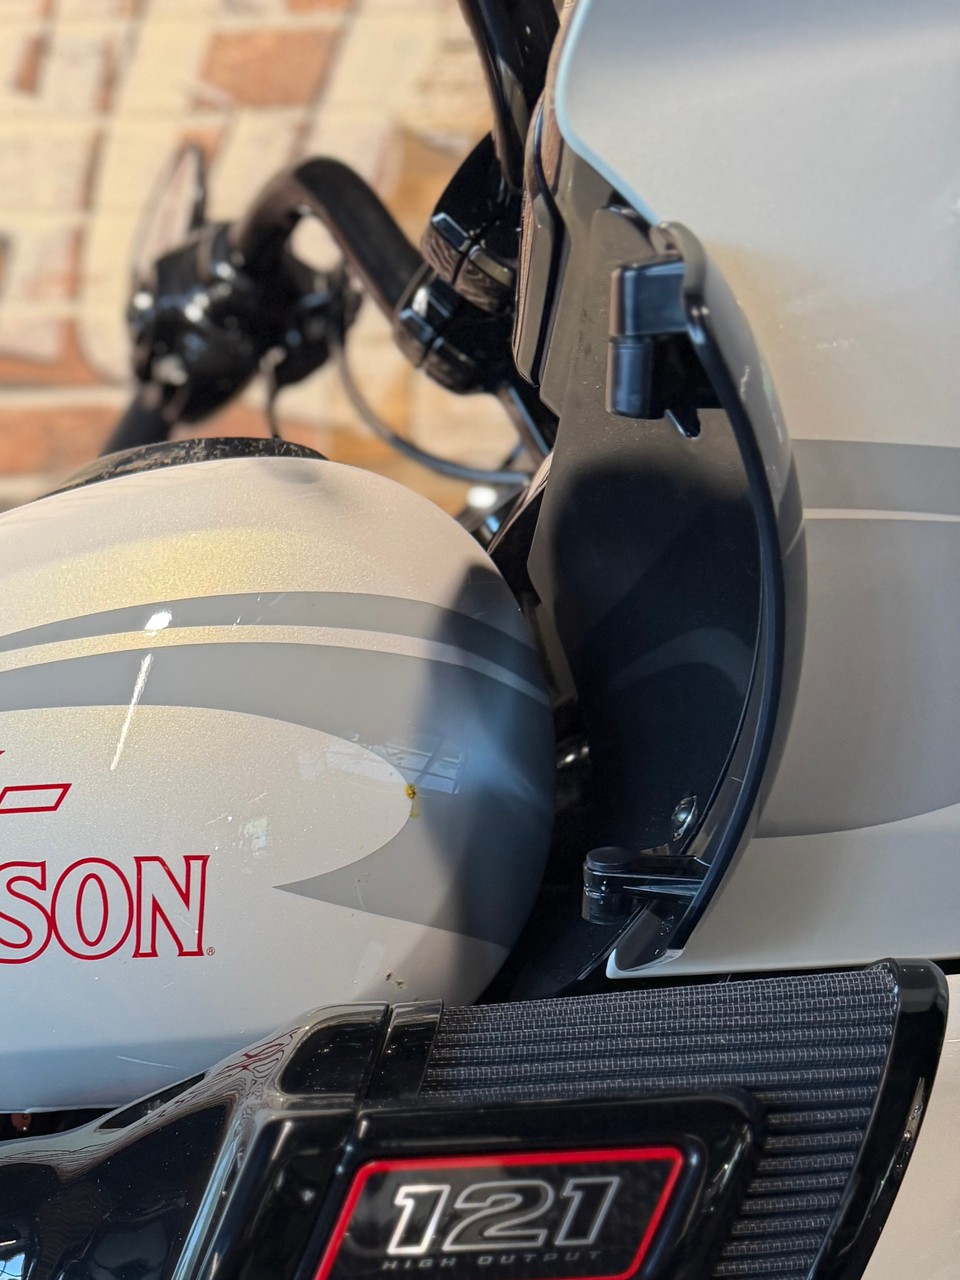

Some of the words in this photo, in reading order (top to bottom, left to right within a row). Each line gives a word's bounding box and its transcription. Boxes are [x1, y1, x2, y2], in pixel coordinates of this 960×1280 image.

[386, 1175, 621, 1255] 121
[382, 1257, 457, 1271] HIGH
[477, 1250, 602, 1266] OUTPUT
